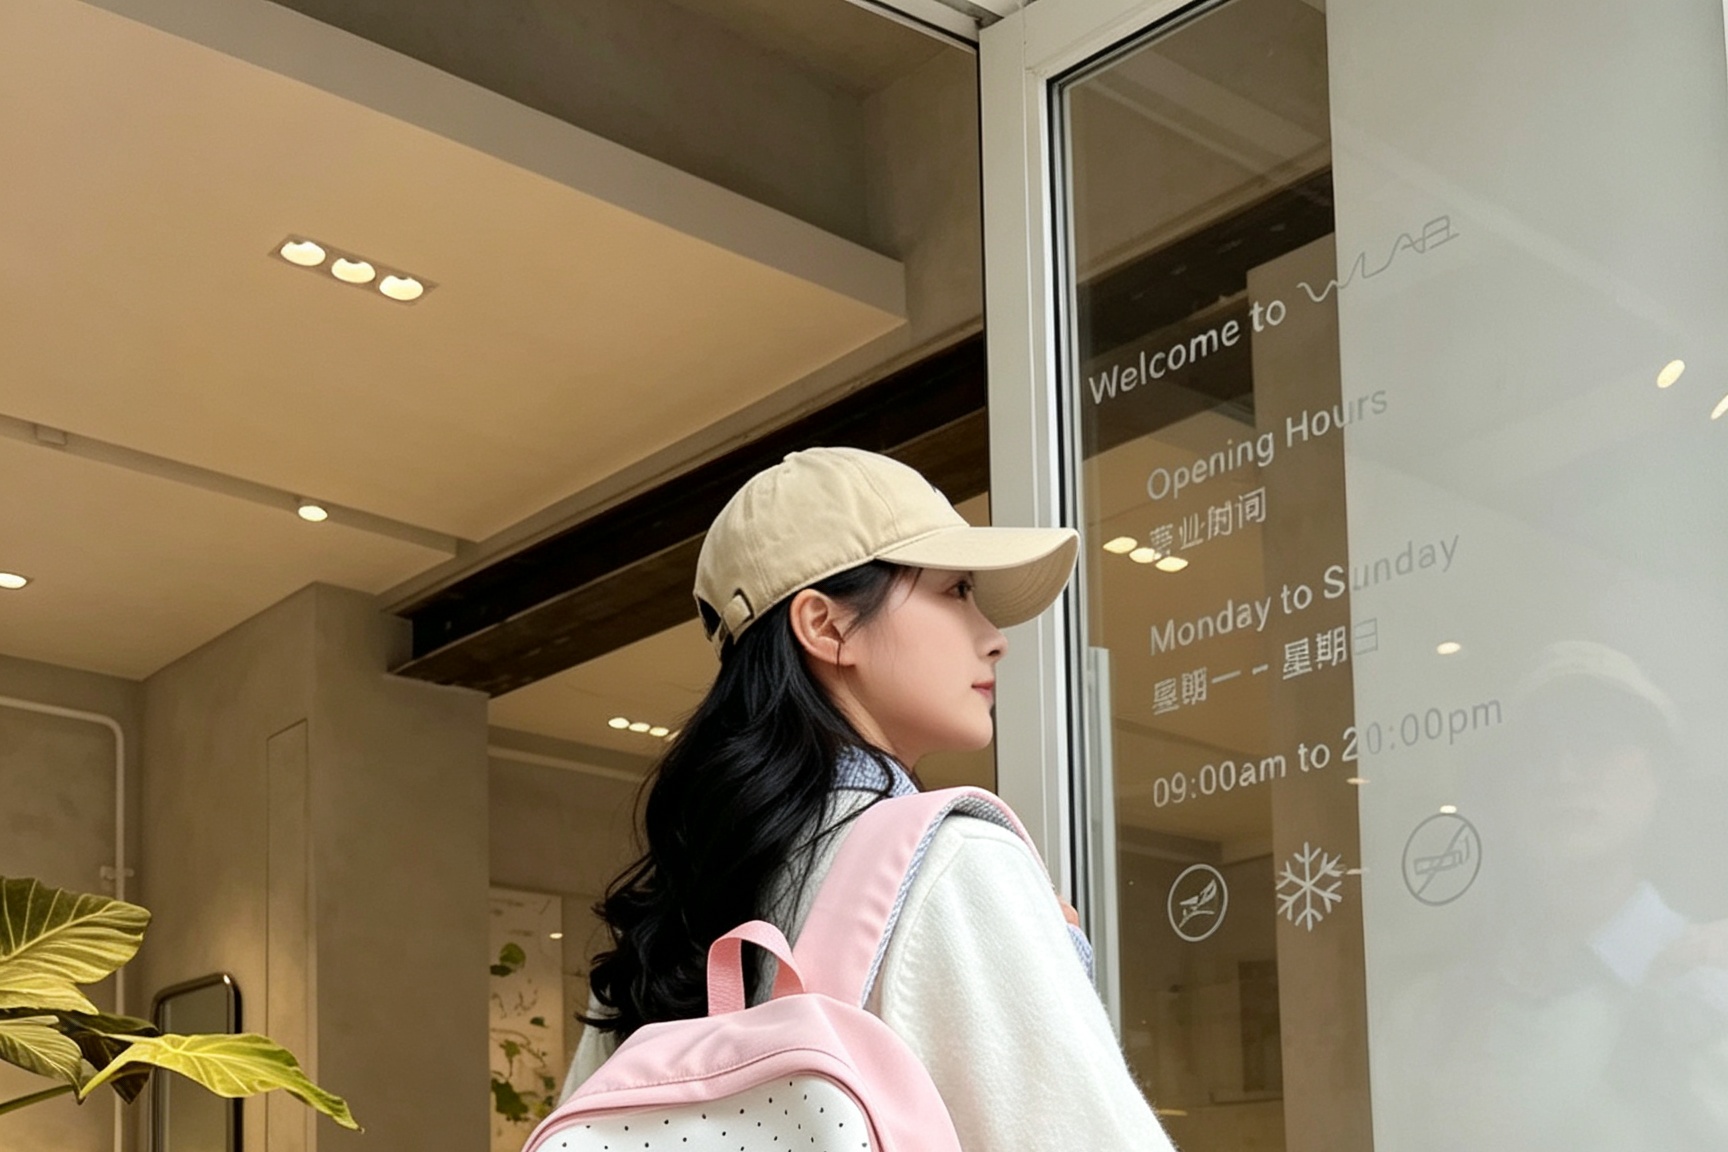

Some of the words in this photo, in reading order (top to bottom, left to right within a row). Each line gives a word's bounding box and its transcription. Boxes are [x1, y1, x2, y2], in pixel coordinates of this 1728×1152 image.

[1088, 319, 1240, 404] Welcome
[1250, 299, 1286, 331] to
[1147, 431, 1275, 500] Opening
[1286, 389, 1388, 447] Hours
[1150, 596, 1272, 656] Monday
[1281, 583, 1312, 614] to
[1323, 534, 1459, 599] Sunday
[1153, 754, 1286, 808] 09:00am
[1298, 741, 1330, 772] to
[1341, 698, 1502, 762] 20:00pm
